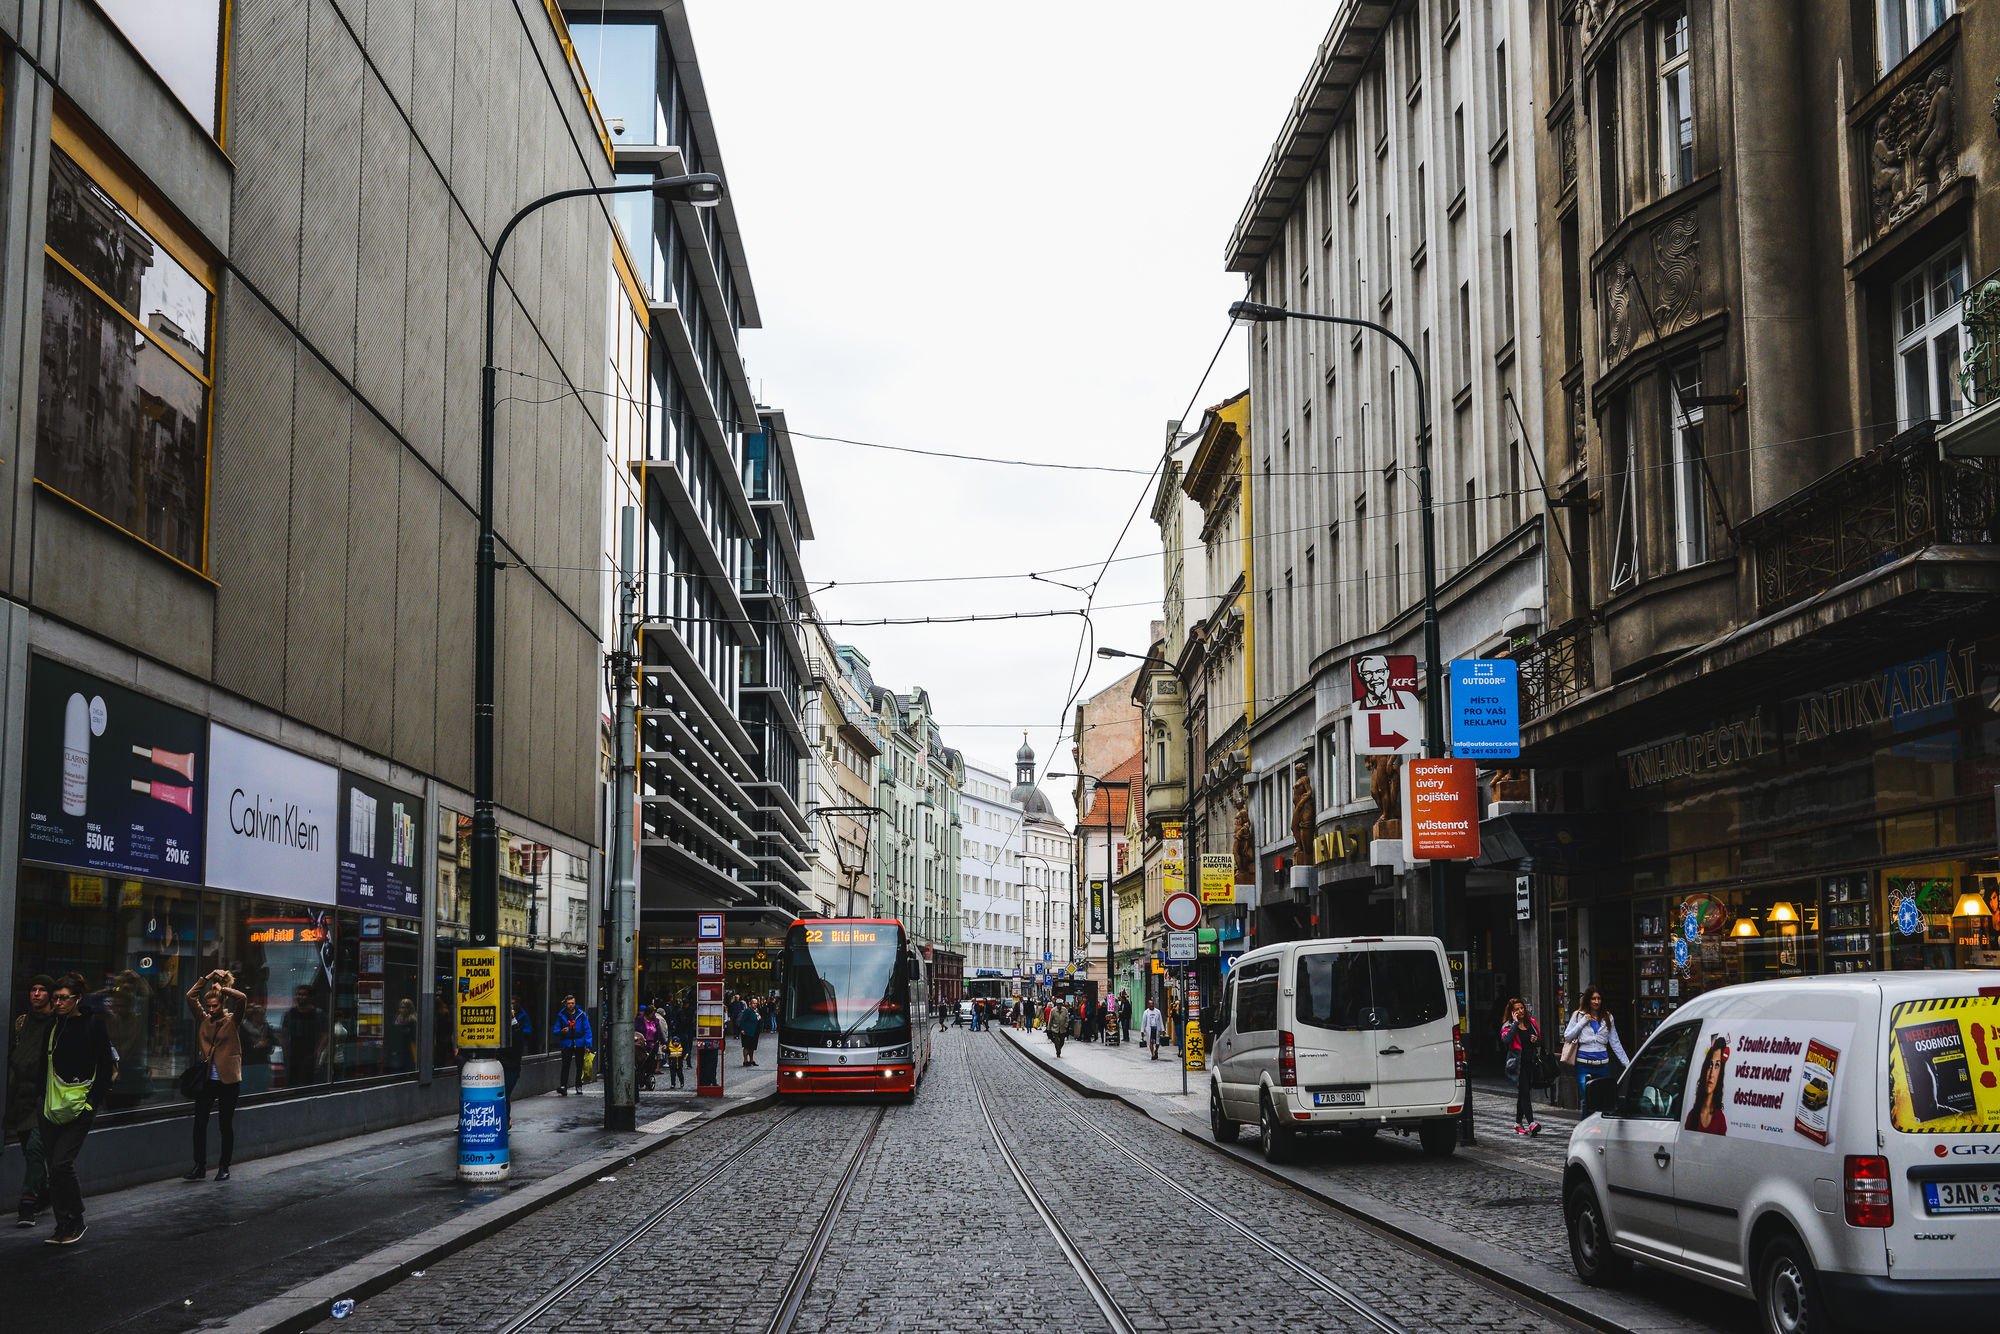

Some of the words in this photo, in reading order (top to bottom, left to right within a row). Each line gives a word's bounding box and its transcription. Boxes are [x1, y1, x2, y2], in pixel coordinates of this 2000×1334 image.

[1392, 678, 1416, 686] KFC
[1470, 696, 1499, 704] MÍSTO
[1795, 639, 1977, 745] ANTIKVARIÁT
[1486, 707, 1506, 715] VAŠI
[1627, 705, 1765, 790] KNIHKUPECTVÍ
[1416, 764, 1452, 776] spoření
[1416, 778, 1444, 789] úvěry
[1416, 792, 1459, 803] pojištění
[230, 788, 281, 844] Calvin
[284, 802, 319, 852] Klein
[1416, 820, 1468, 830] wüstenrot
[86, 832, 102, 850] 550
[104, 835, 114, 852] Kč
[166, 847, 178, 864] 290
[180, 850, 190, 866] Kč
[806, 930, 823, 942] 22
[832, 930, 850, 942] Bílá
[854, 930, 876, 942] Hora
[462, 956, 494, 966] REKLAMNÍ
[466, 968, 490, 977] PLOCHA
[470, 978, 494, 1000] NÁJMU
[1905, 1021, 1958, 1042] NEBEZPEČNÉ
[1737, 1036, 1745, 1052] S
[1743, 1036, 1770, 1054] touhle
[1915, 1035, 1960, 1052] OSOBNOSTI
[1736, 1061, 1749, 1079] vás
[1750, 1065, 1761, 1079] za
[1761, 1064, 1792, 1082] volant
[1320, 1094, 1335, 1103] 7A8
[1342, 1093, 1360, 1102] 9800
[1734, 1088, 1784, 1109] dostaneme!
[464, 1102, 495, 1118] Kurzy
[460, 1115, 502, 1132] ngličtiny
[462, 1154, 483, 1162] 150m
[1942, 1184, 1979, 1204] 3AN
